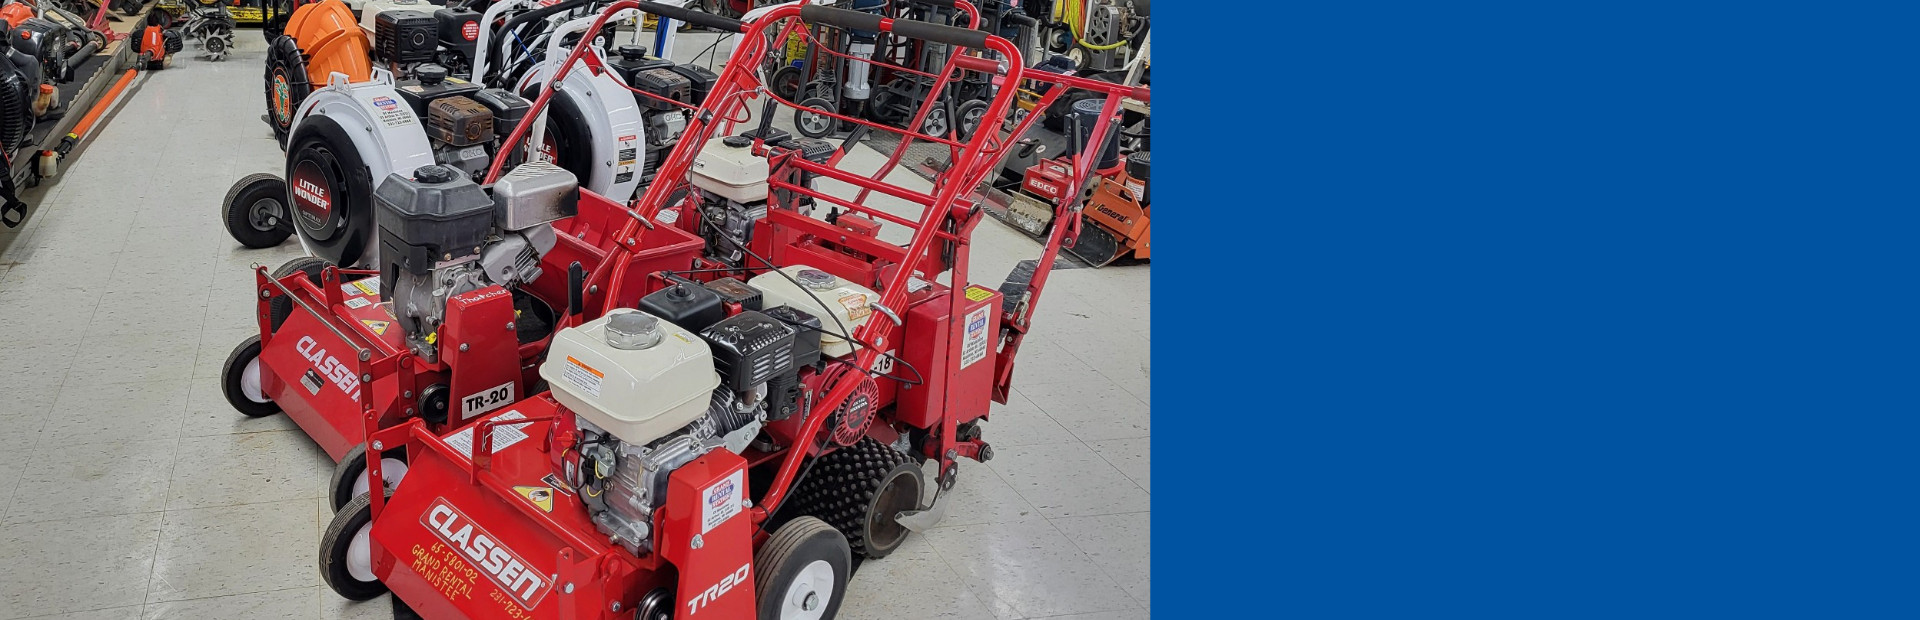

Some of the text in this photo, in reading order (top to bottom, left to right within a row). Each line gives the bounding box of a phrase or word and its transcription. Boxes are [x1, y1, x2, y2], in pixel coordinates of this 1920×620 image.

[294, 185, 328, 210] WONDER
[299, 178, 325, 198] LITTLE
[1029, 179, 1058, 195] EDCO
[1096, 203, 1128, 223] General
[465, 387, 509, 412] TR-20
[429, 504, 542, 602] CLASSEN
[431, 541, 478, 585] 65-5801-02
[412, 543, 472, 600] GRAND RENTAL
[412, 559, 460, 601] MANISTEE
[687, 562, 750, 616] TR20
